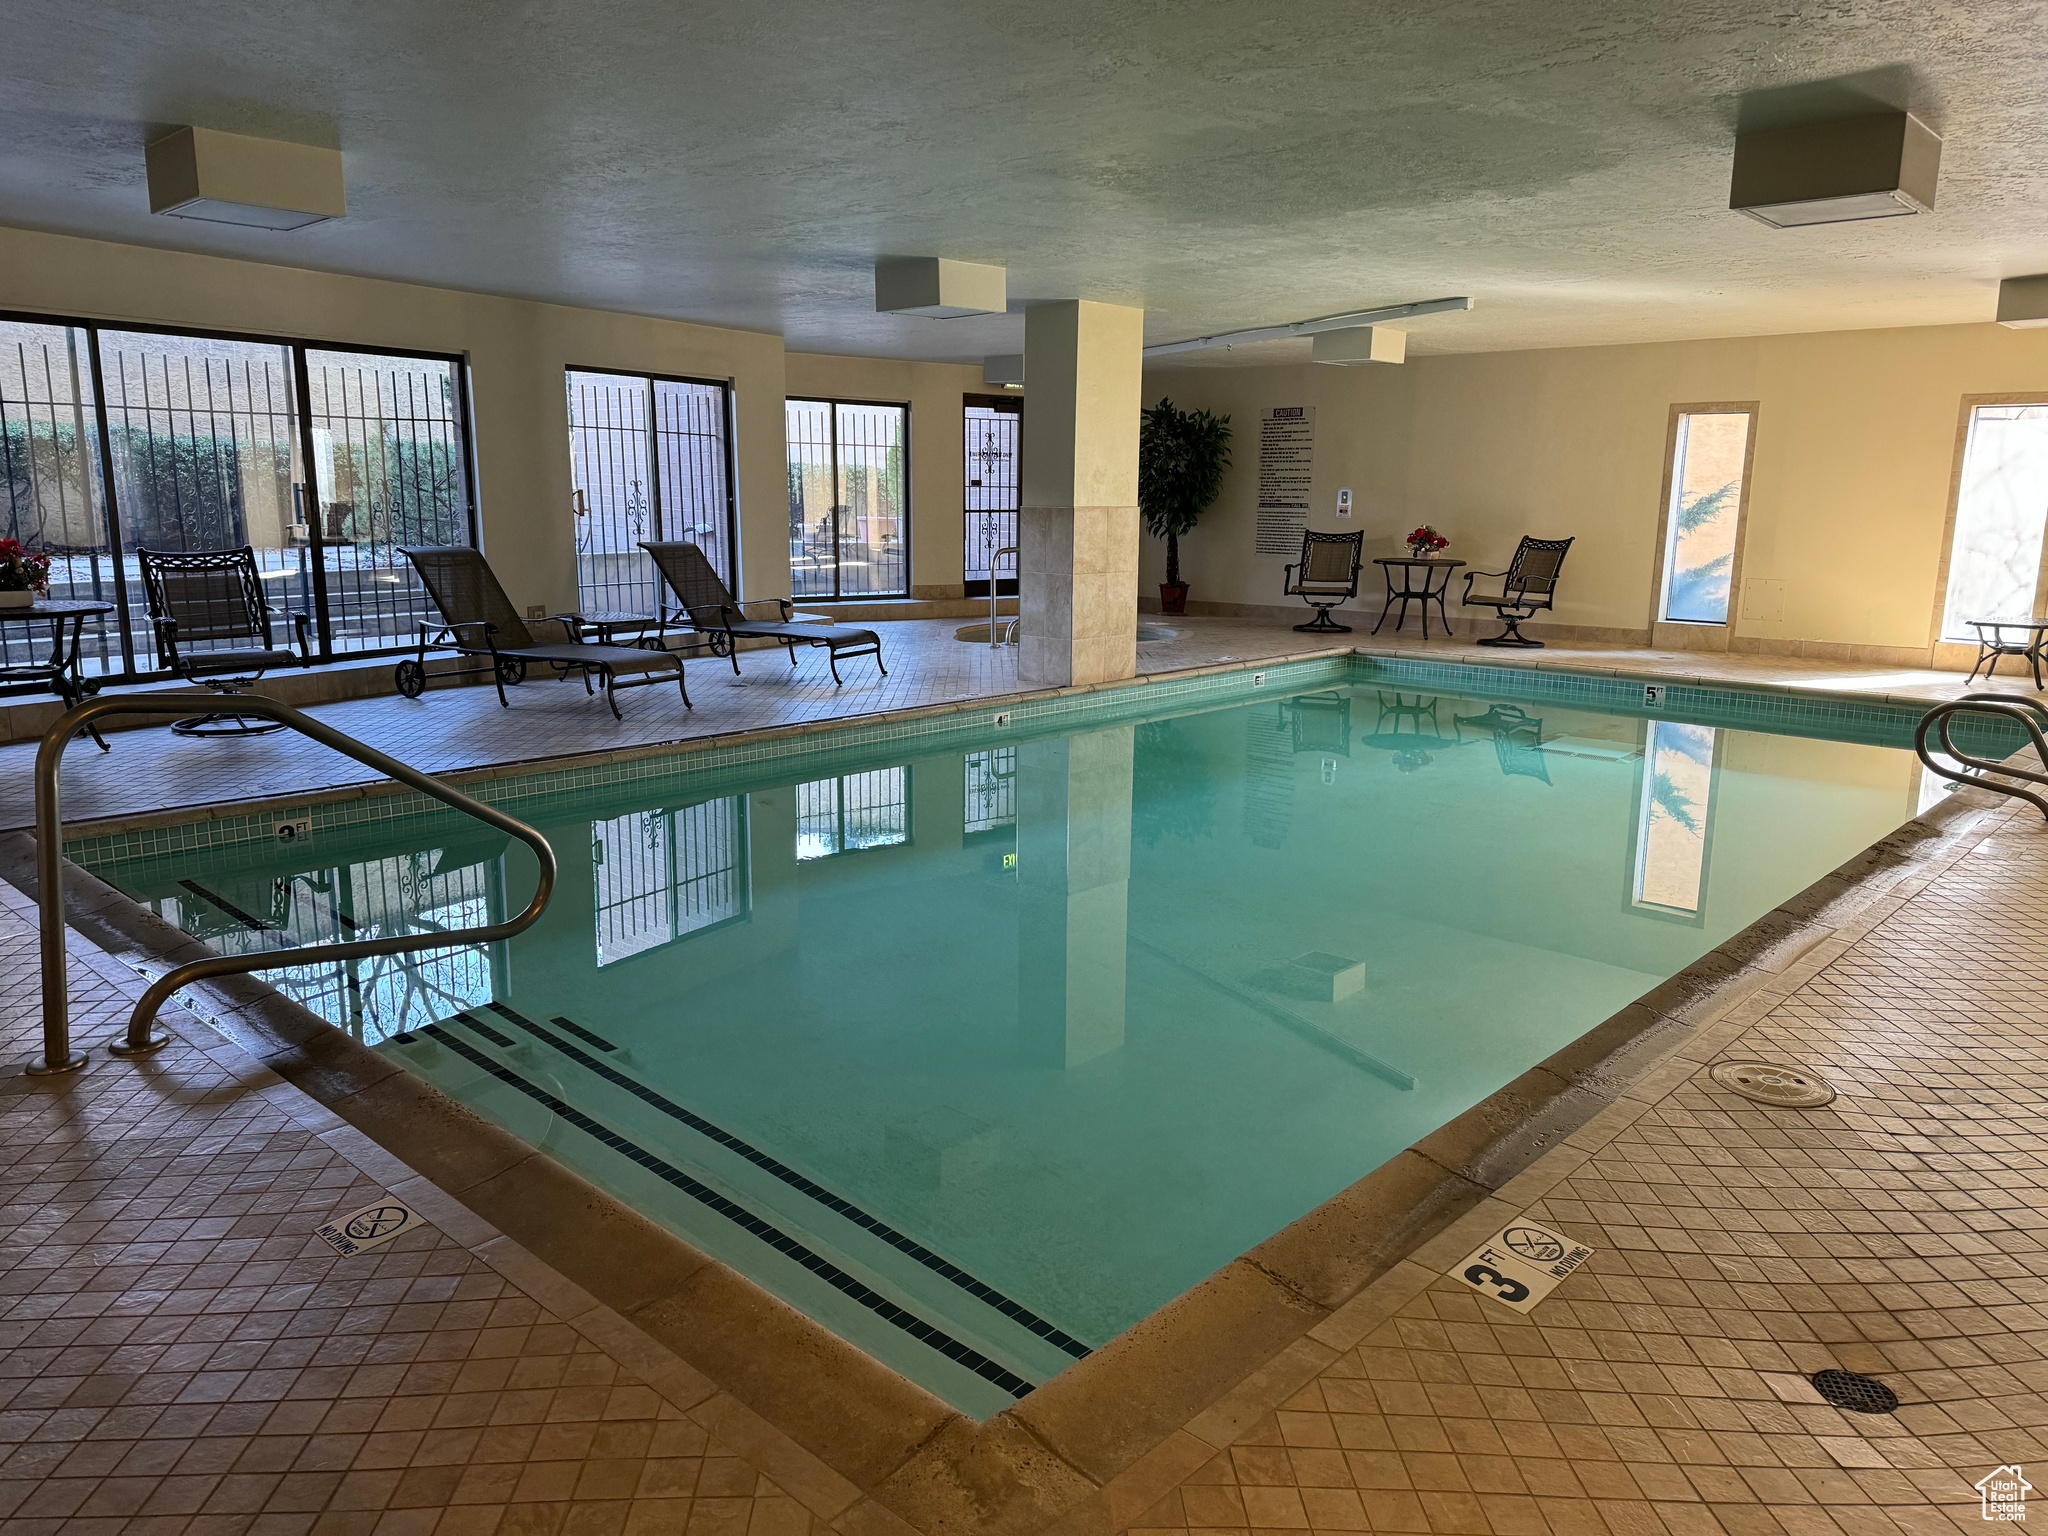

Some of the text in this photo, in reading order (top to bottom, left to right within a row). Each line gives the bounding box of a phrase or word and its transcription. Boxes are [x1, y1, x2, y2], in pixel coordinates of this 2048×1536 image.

[1275, 409, 1301, 417] CAUTION
[1646, 686, 1656, 698] 5
[296, 821, 308, 832] FT
[318, 1224, 360, 1255] NO DIVING
[1549, 1246, 1591, 1279] NO DIVING
[1464, 1248, 1530, 1303] 3 FT
